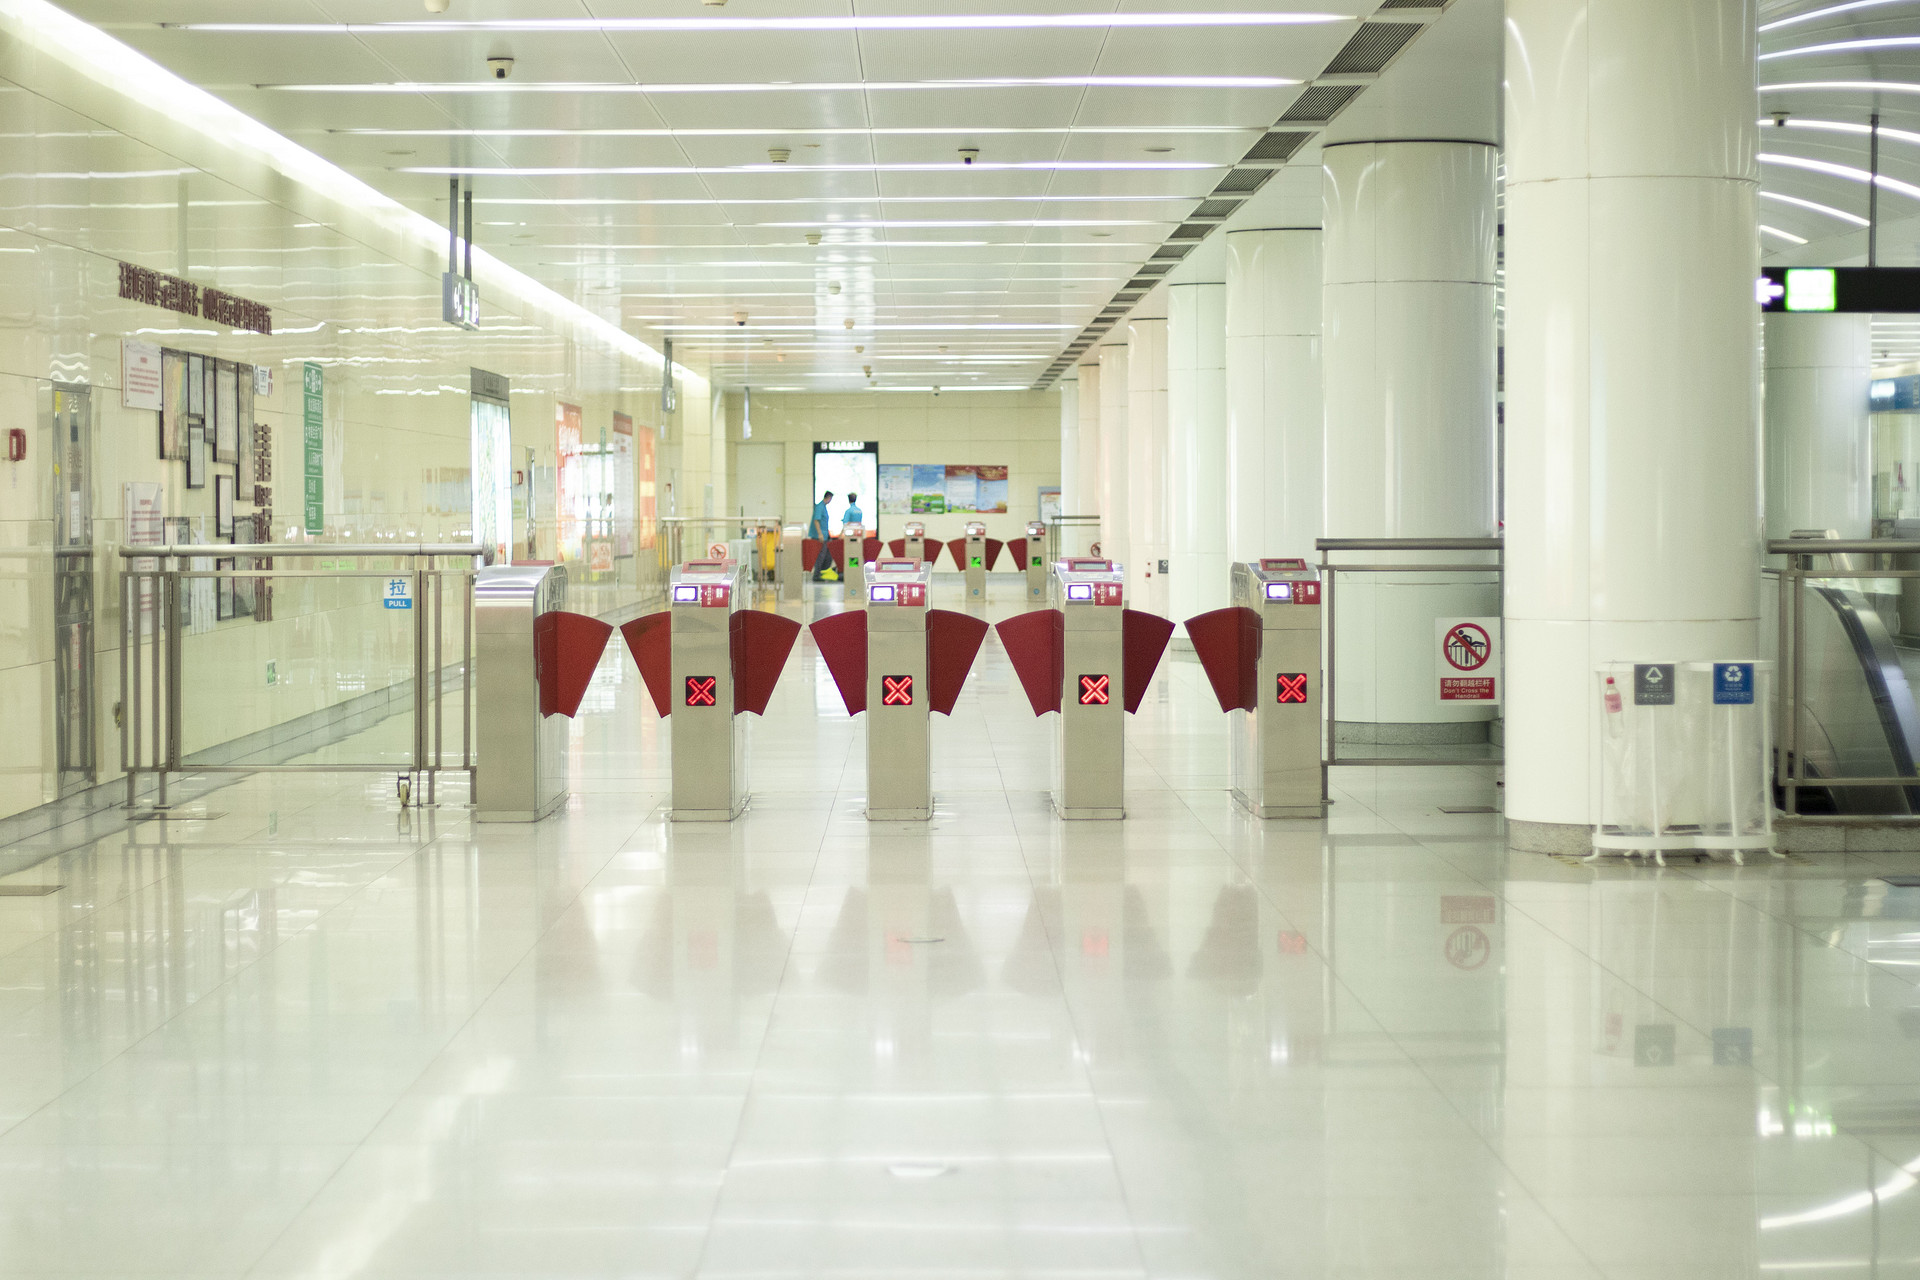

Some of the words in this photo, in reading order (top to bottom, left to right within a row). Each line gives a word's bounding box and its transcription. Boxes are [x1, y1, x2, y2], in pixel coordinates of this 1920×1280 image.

[389, 579, 406, 596] 拉
[1444, 679, 1491, 688] 请勿翻越栏杆
